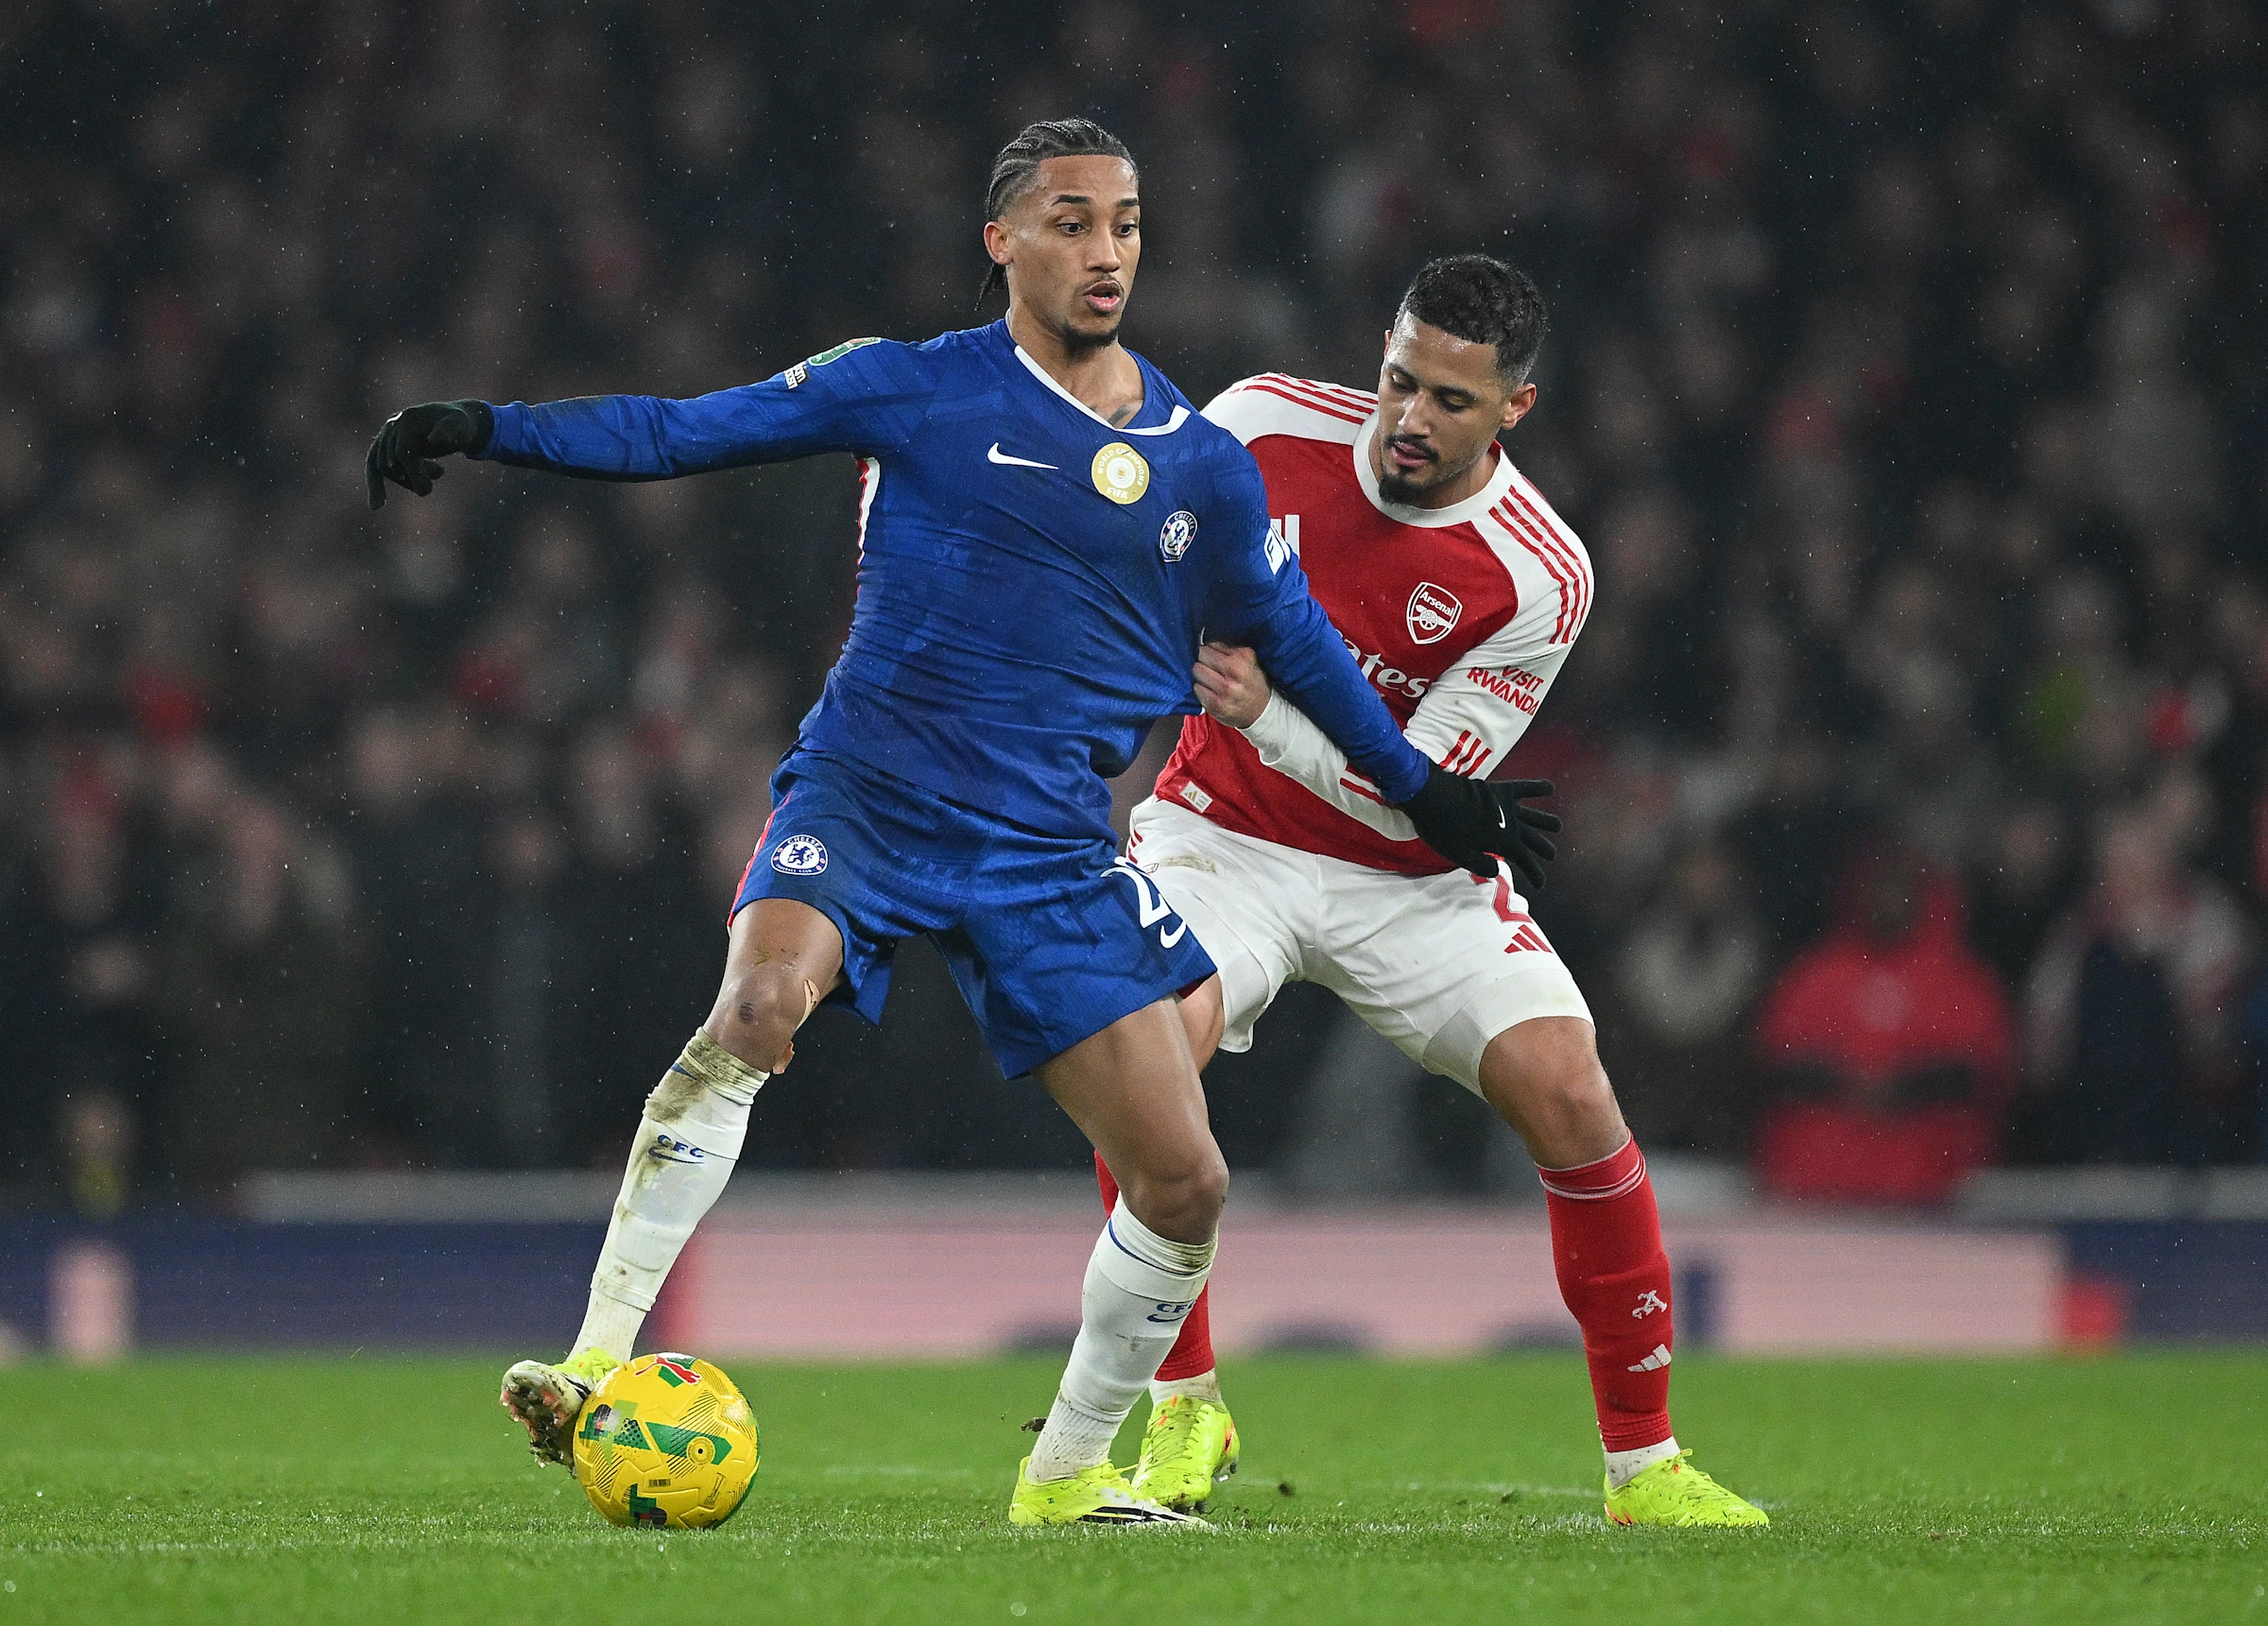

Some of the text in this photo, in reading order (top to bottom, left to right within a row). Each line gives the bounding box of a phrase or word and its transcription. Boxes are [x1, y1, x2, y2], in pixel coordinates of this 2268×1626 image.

[1097, 448, 1145, 488] WORLD CHAMPIONS
[1107, 487, 1129, 500] FIFA
[1174, 513, 1195, 530] CHELSEA
[1419, 590, 1455, 617] Arsenal
[1467, 666, 1540, 716] RWANDA
[1502, 664, 1545, 693] VISIT
[787, 836, 823, 852] CHELSEA
[657, 1134, 704, 1158] CFC
